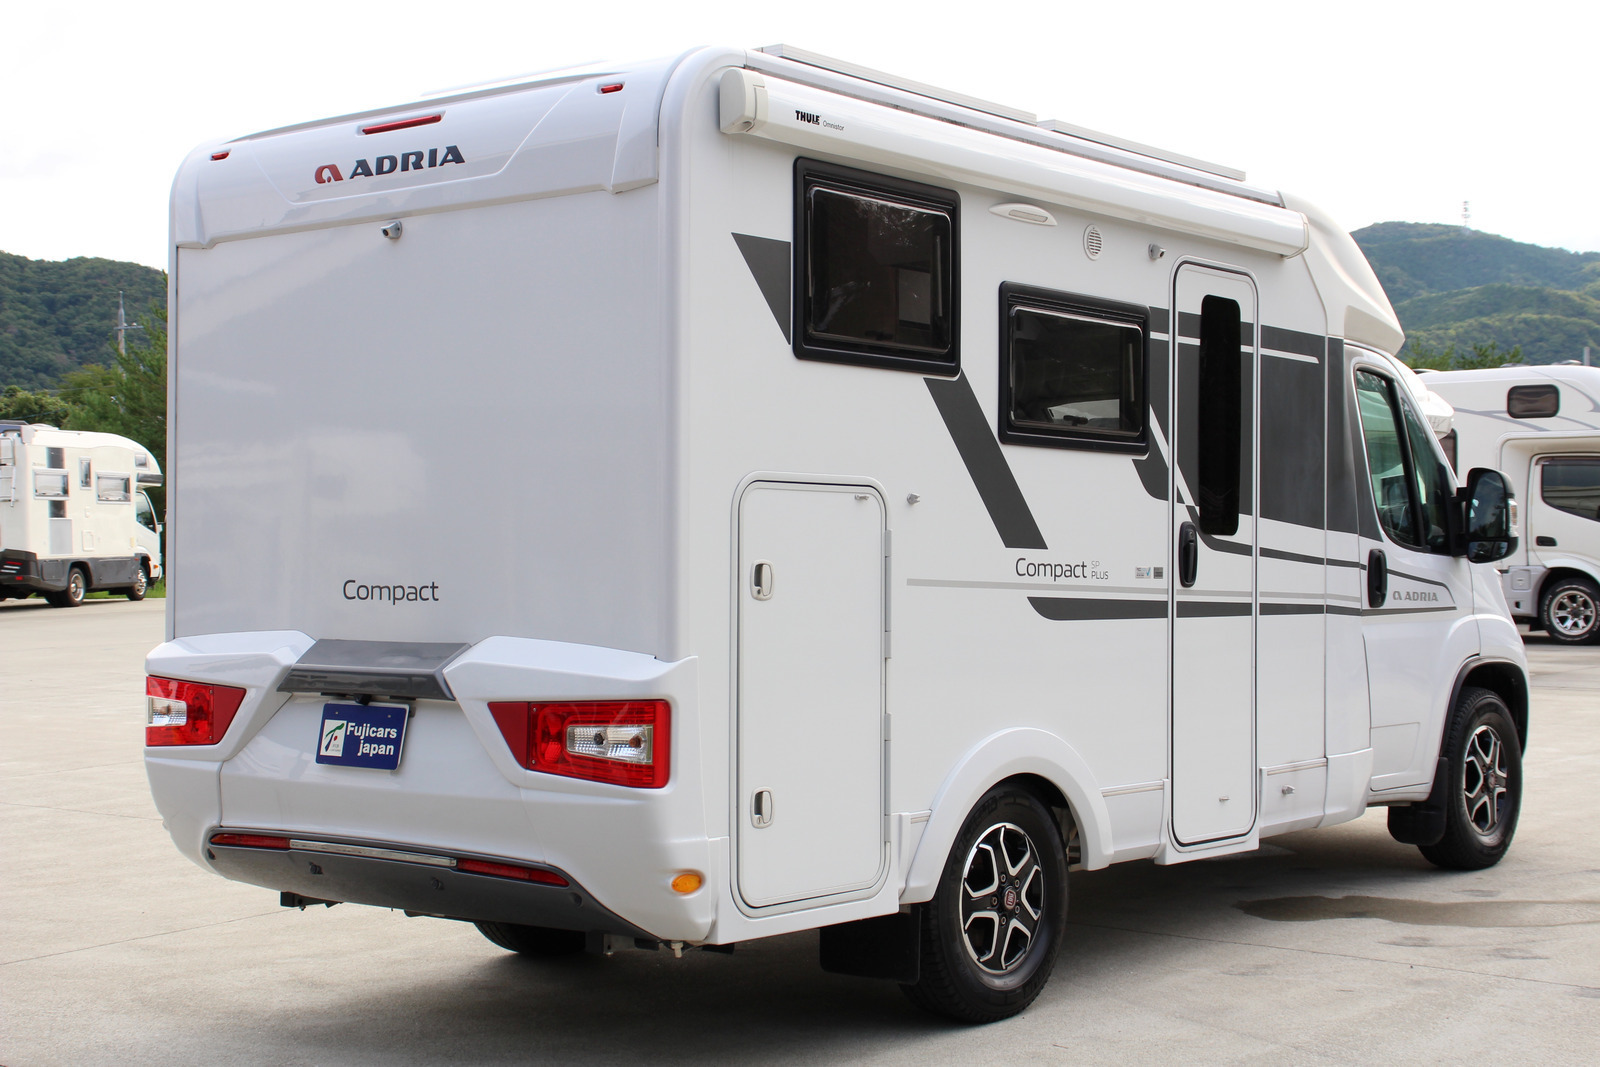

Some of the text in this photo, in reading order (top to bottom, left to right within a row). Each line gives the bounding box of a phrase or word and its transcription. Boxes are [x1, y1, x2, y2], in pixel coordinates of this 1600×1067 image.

[795, 110, 820, 124] THULE
[349, 145, 465, 179] ADRIA
[1015, 558, 1100, 581] Compact SP
[1091, 571, 1109, 579] PLUS
[343, 579, 439, 605] Compact
[1404, 591, 1439, 601] ADRIA
[346, 722, 398, 740] Fujicars
[357, 740, 395, 757] japan
